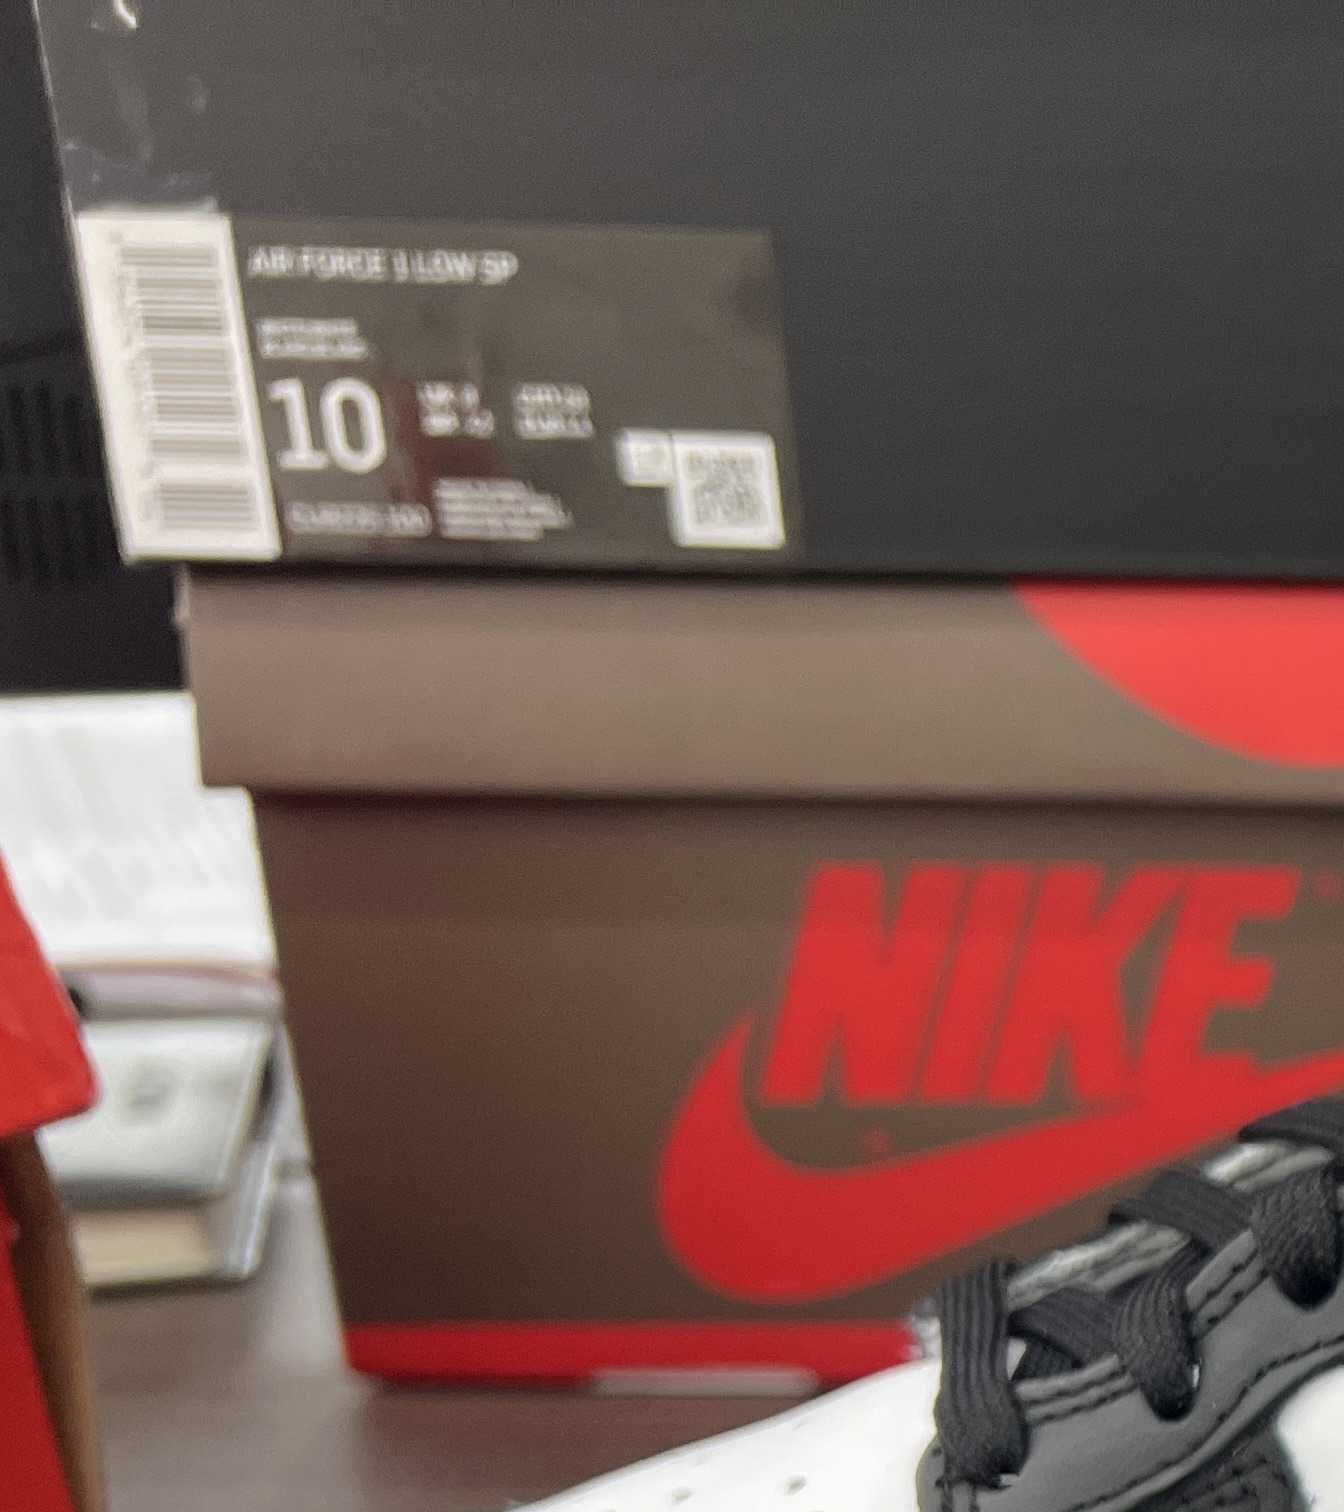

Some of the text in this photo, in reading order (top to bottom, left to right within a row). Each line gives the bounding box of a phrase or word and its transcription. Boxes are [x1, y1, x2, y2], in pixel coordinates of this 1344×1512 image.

[300, 247, 388, 281] FORCE
[412, 249, 476, 284] LOW
[270, 378, 387, 474] 10
[762, 860, 1303, 1106] NIKE
